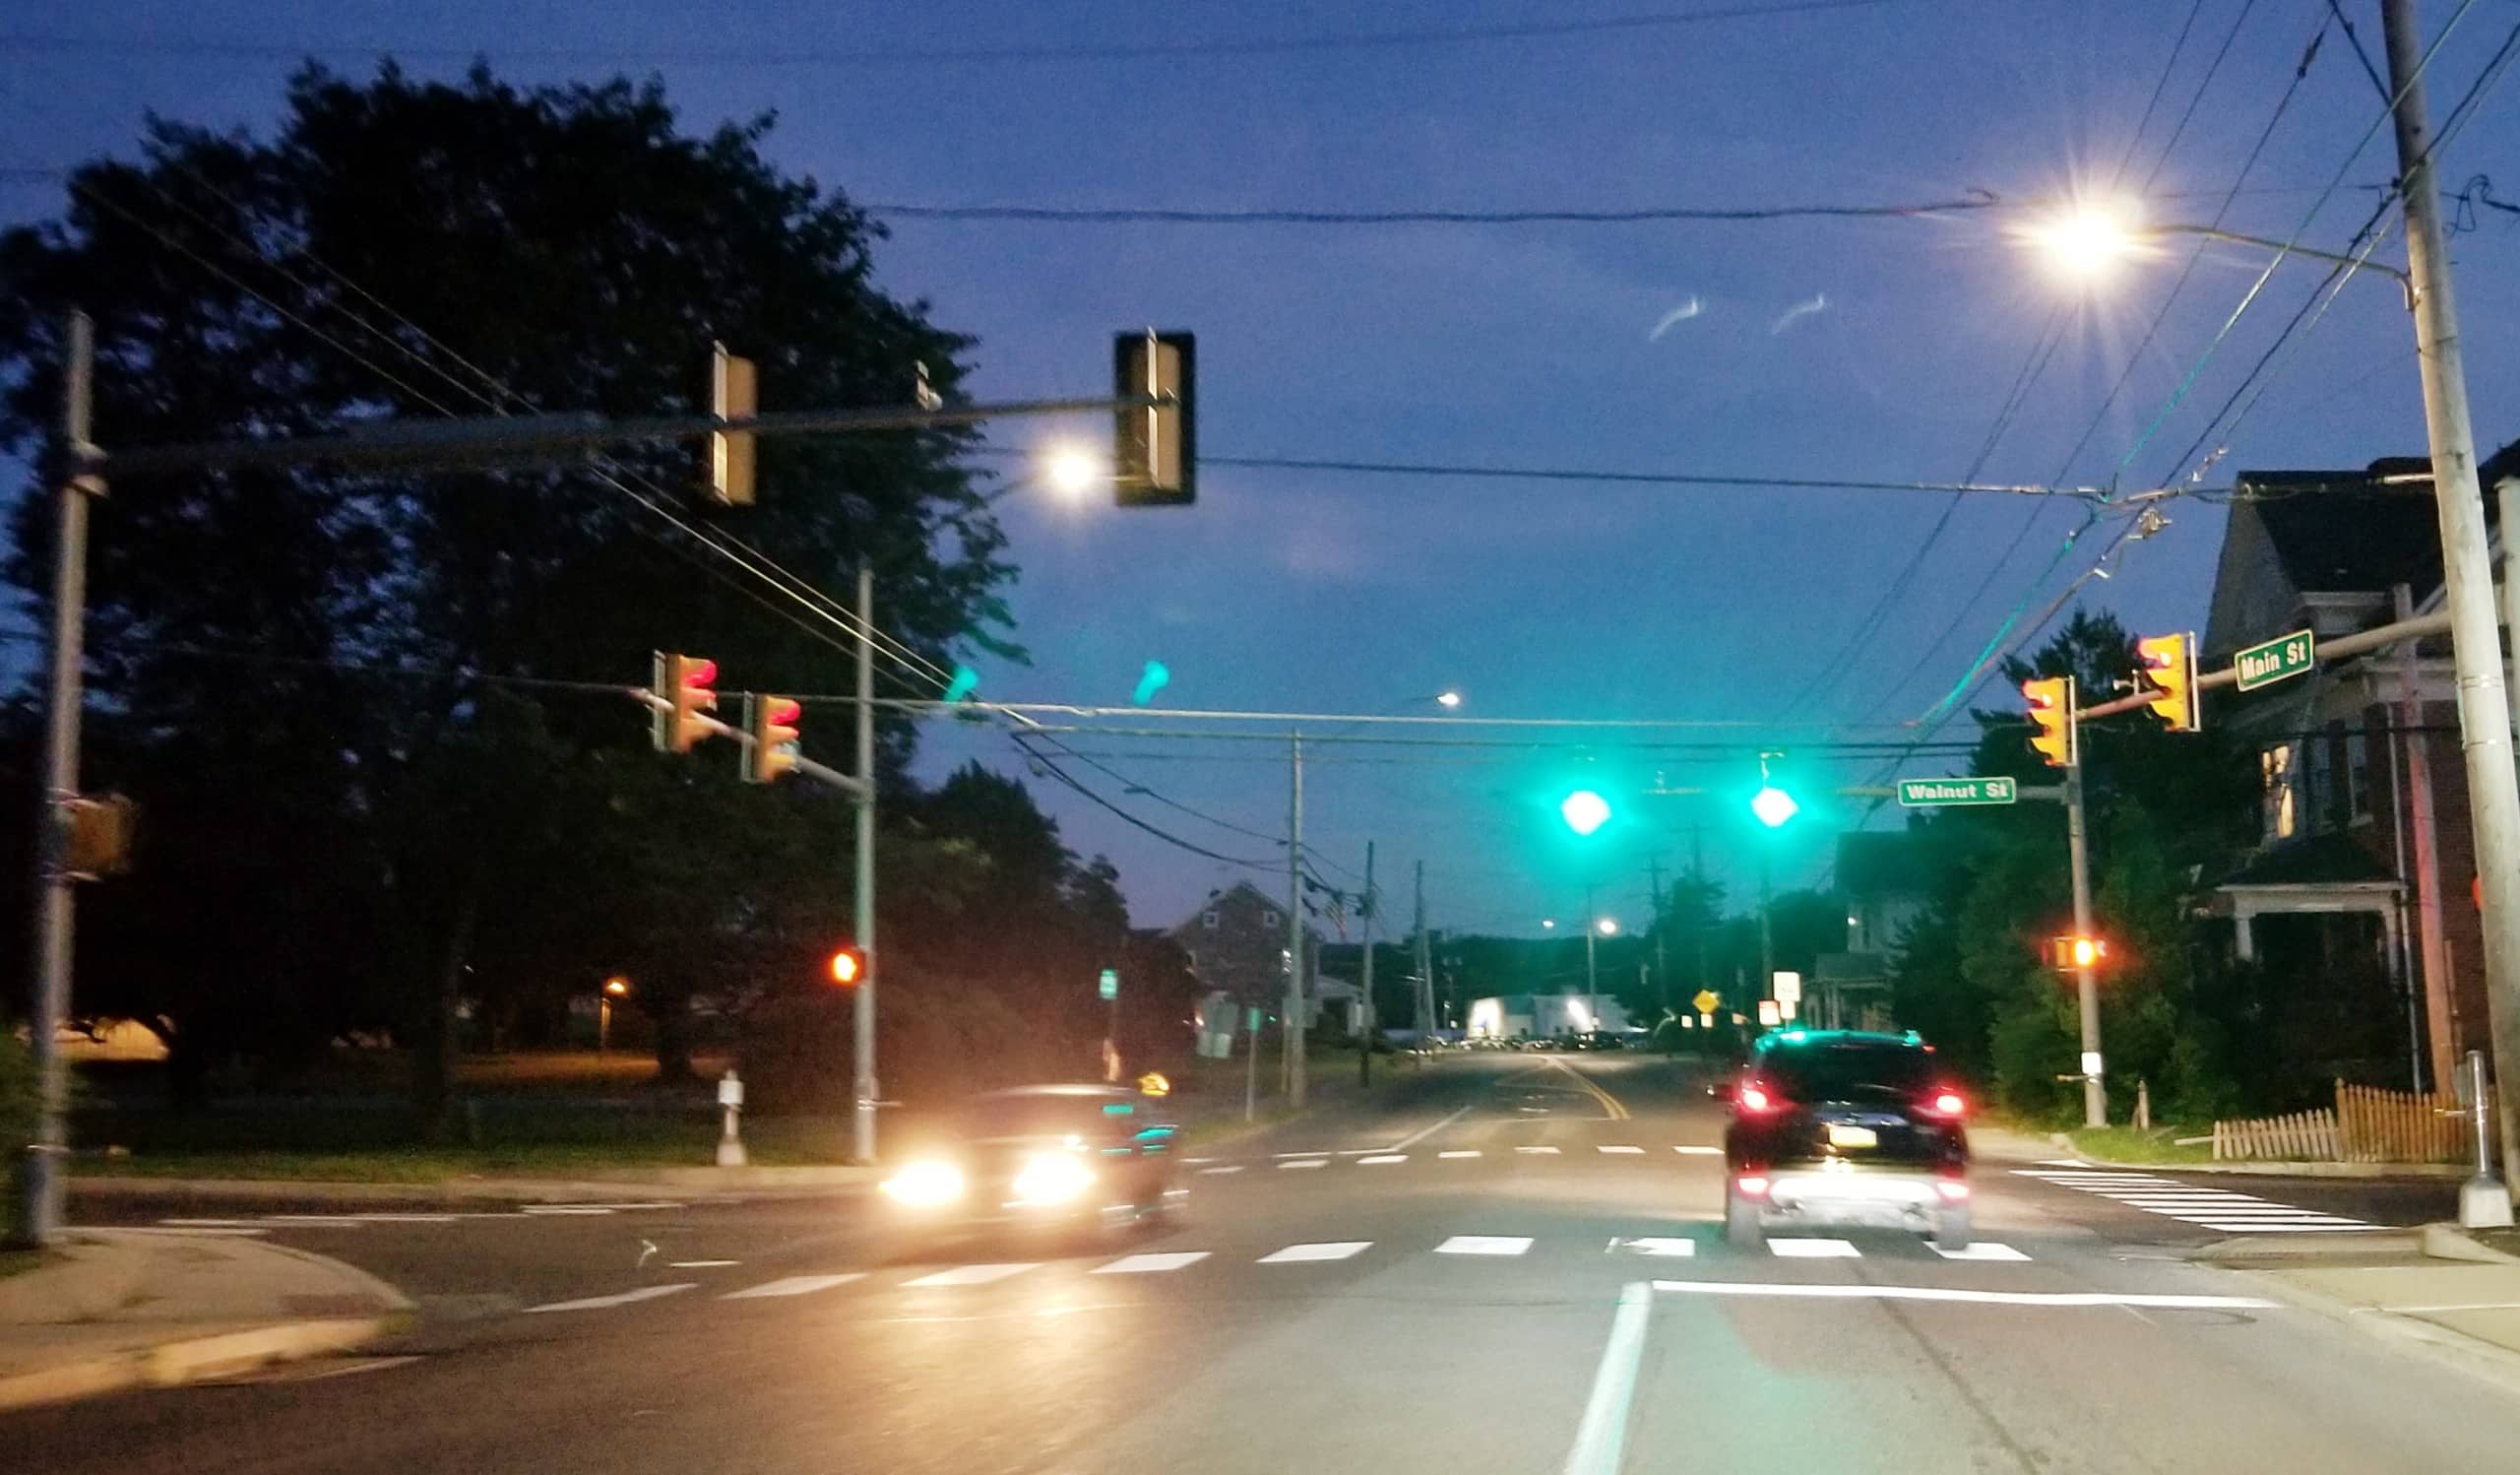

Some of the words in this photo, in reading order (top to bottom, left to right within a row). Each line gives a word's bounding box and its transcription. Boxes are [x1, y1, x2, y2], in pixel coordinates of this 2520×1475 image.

[2240, 651, 2281, 680] Main
[2286, 641, 2306, 666] St
[1906, 783, 1978, 800] Walnut
[1984, 782, 2008, 799] St
